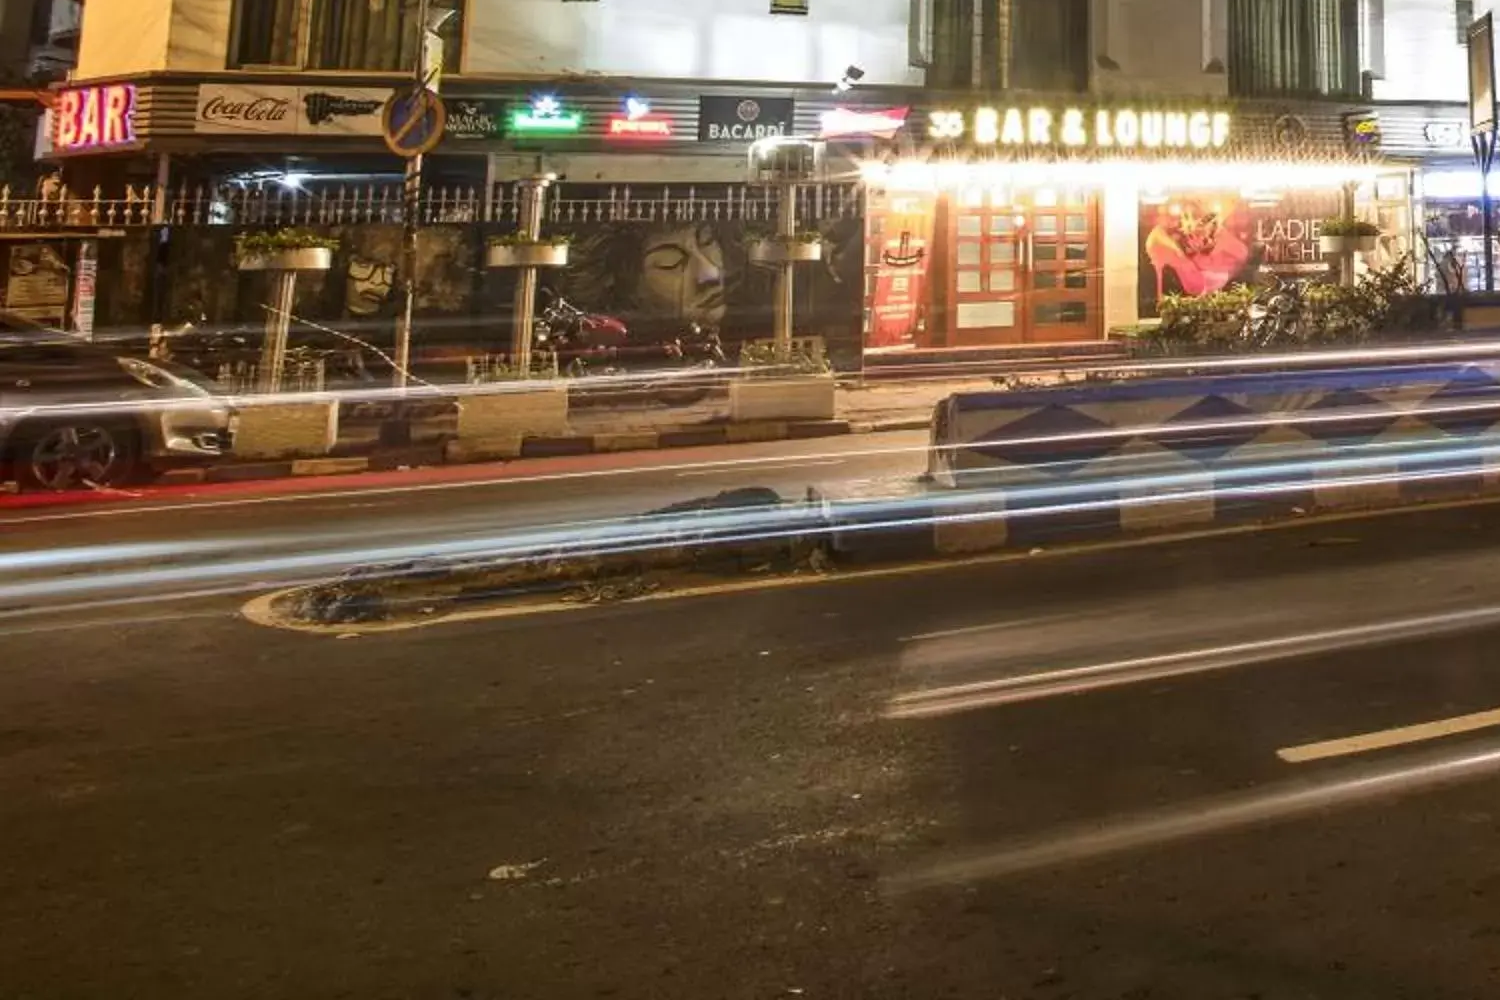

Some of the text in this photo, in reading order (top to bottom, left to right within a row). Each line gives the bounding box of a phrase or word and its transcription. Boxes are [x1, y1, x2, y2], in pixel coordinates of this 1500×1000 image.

[58, 86, 130, 147] BAR
[974, 106, 1052, 145] BAR
[1060, 108, 1088, 146] &
[1256, 219, 1324, 242] LADIE
